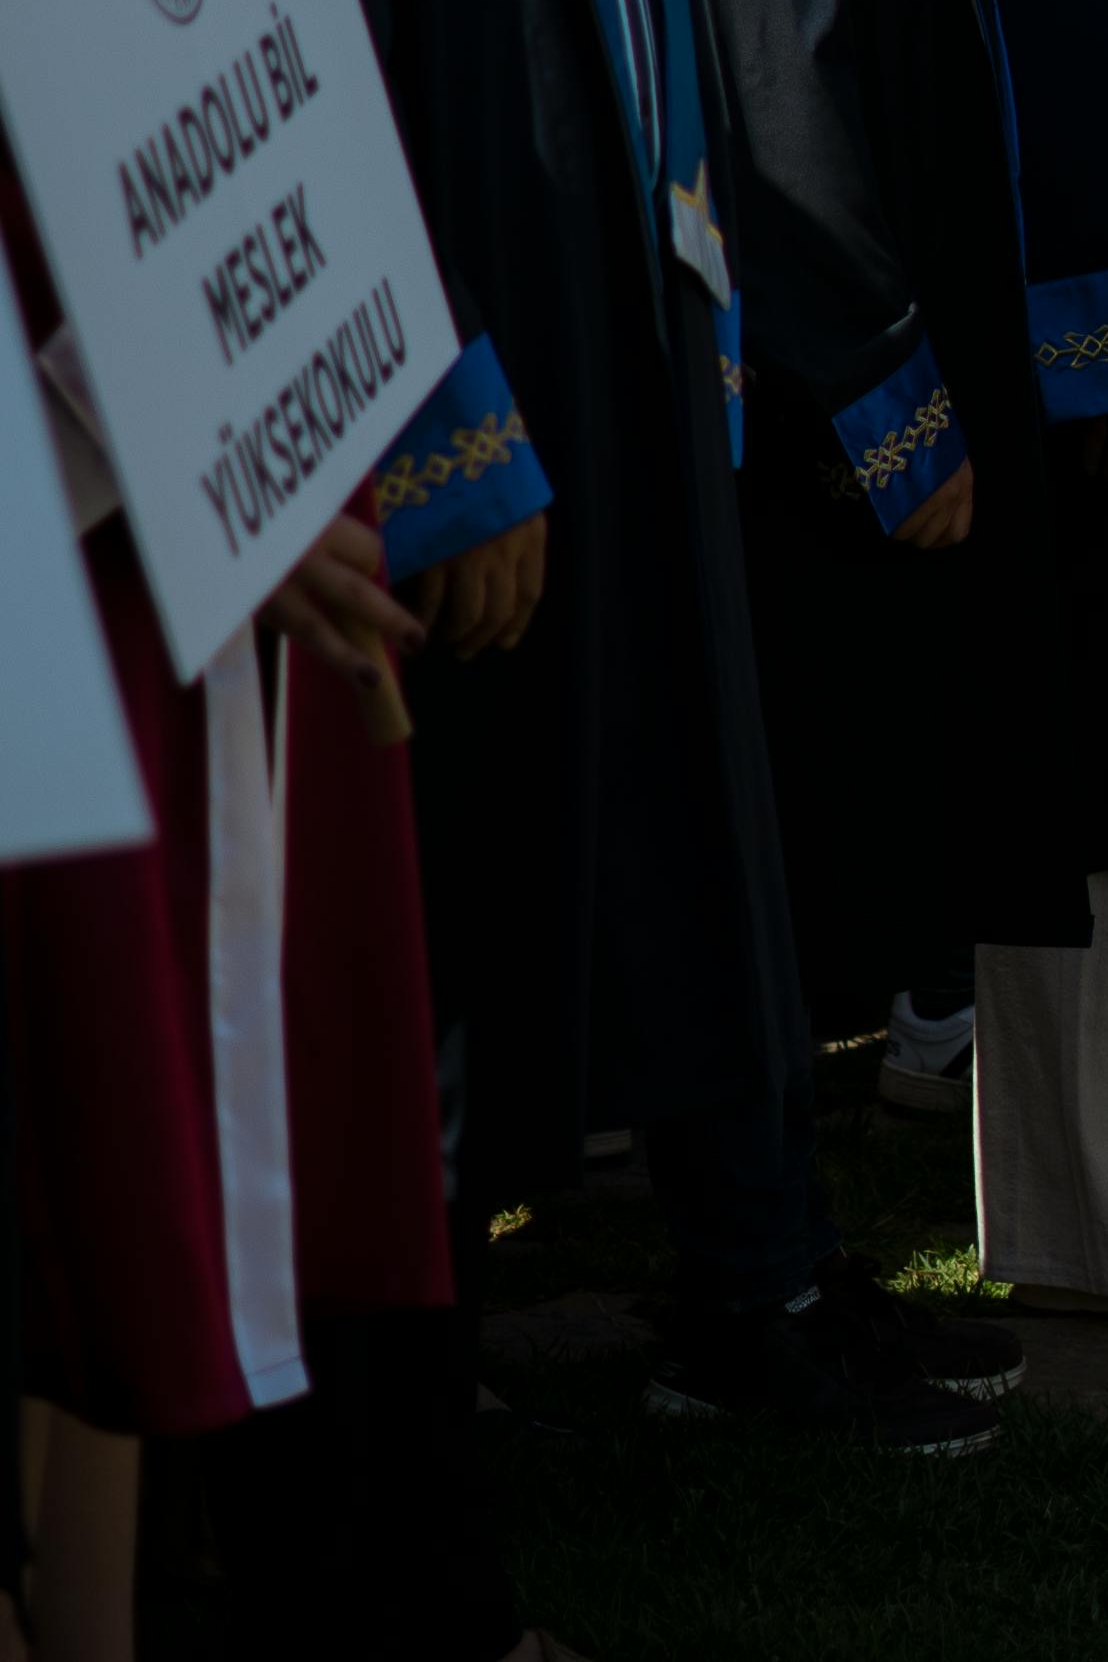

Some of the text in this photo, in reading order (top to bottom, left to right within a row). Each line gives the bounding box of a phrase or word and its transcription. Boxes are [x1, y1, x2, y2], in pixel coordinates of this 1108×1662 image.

[117, 0, 320, 261] ANADOLU BİL
[202, 180, 327, 367] MESLEK
[202, 276, 406, 557] YÜKSEKOKULU
